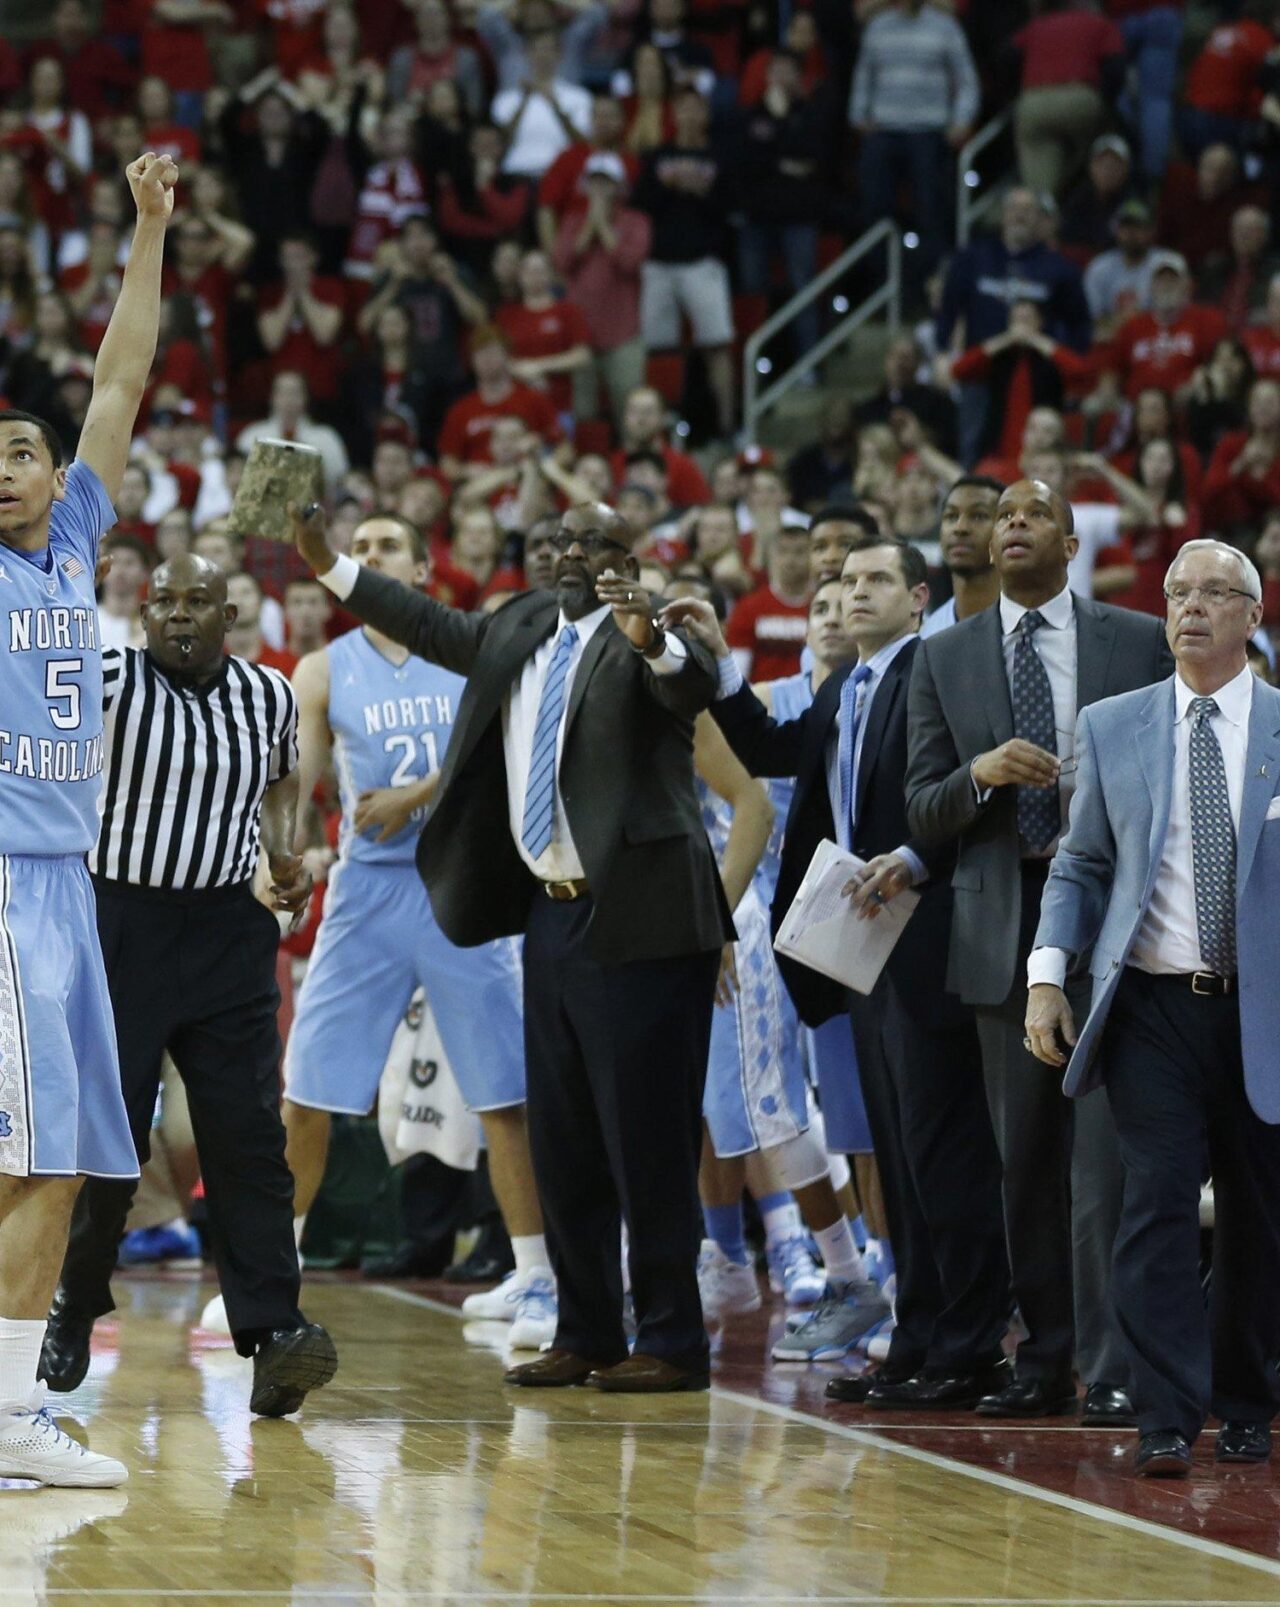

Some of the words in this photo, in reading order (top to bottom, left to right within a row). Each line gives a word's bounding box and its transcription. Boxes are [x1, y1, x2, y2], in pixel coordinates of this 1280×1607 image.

[9, 607, 97, 652] NORTH
[45, 658, 83, 730] 5
[363, 695, 453, 735] NORTH
[384, 731, 439, 788] 21
